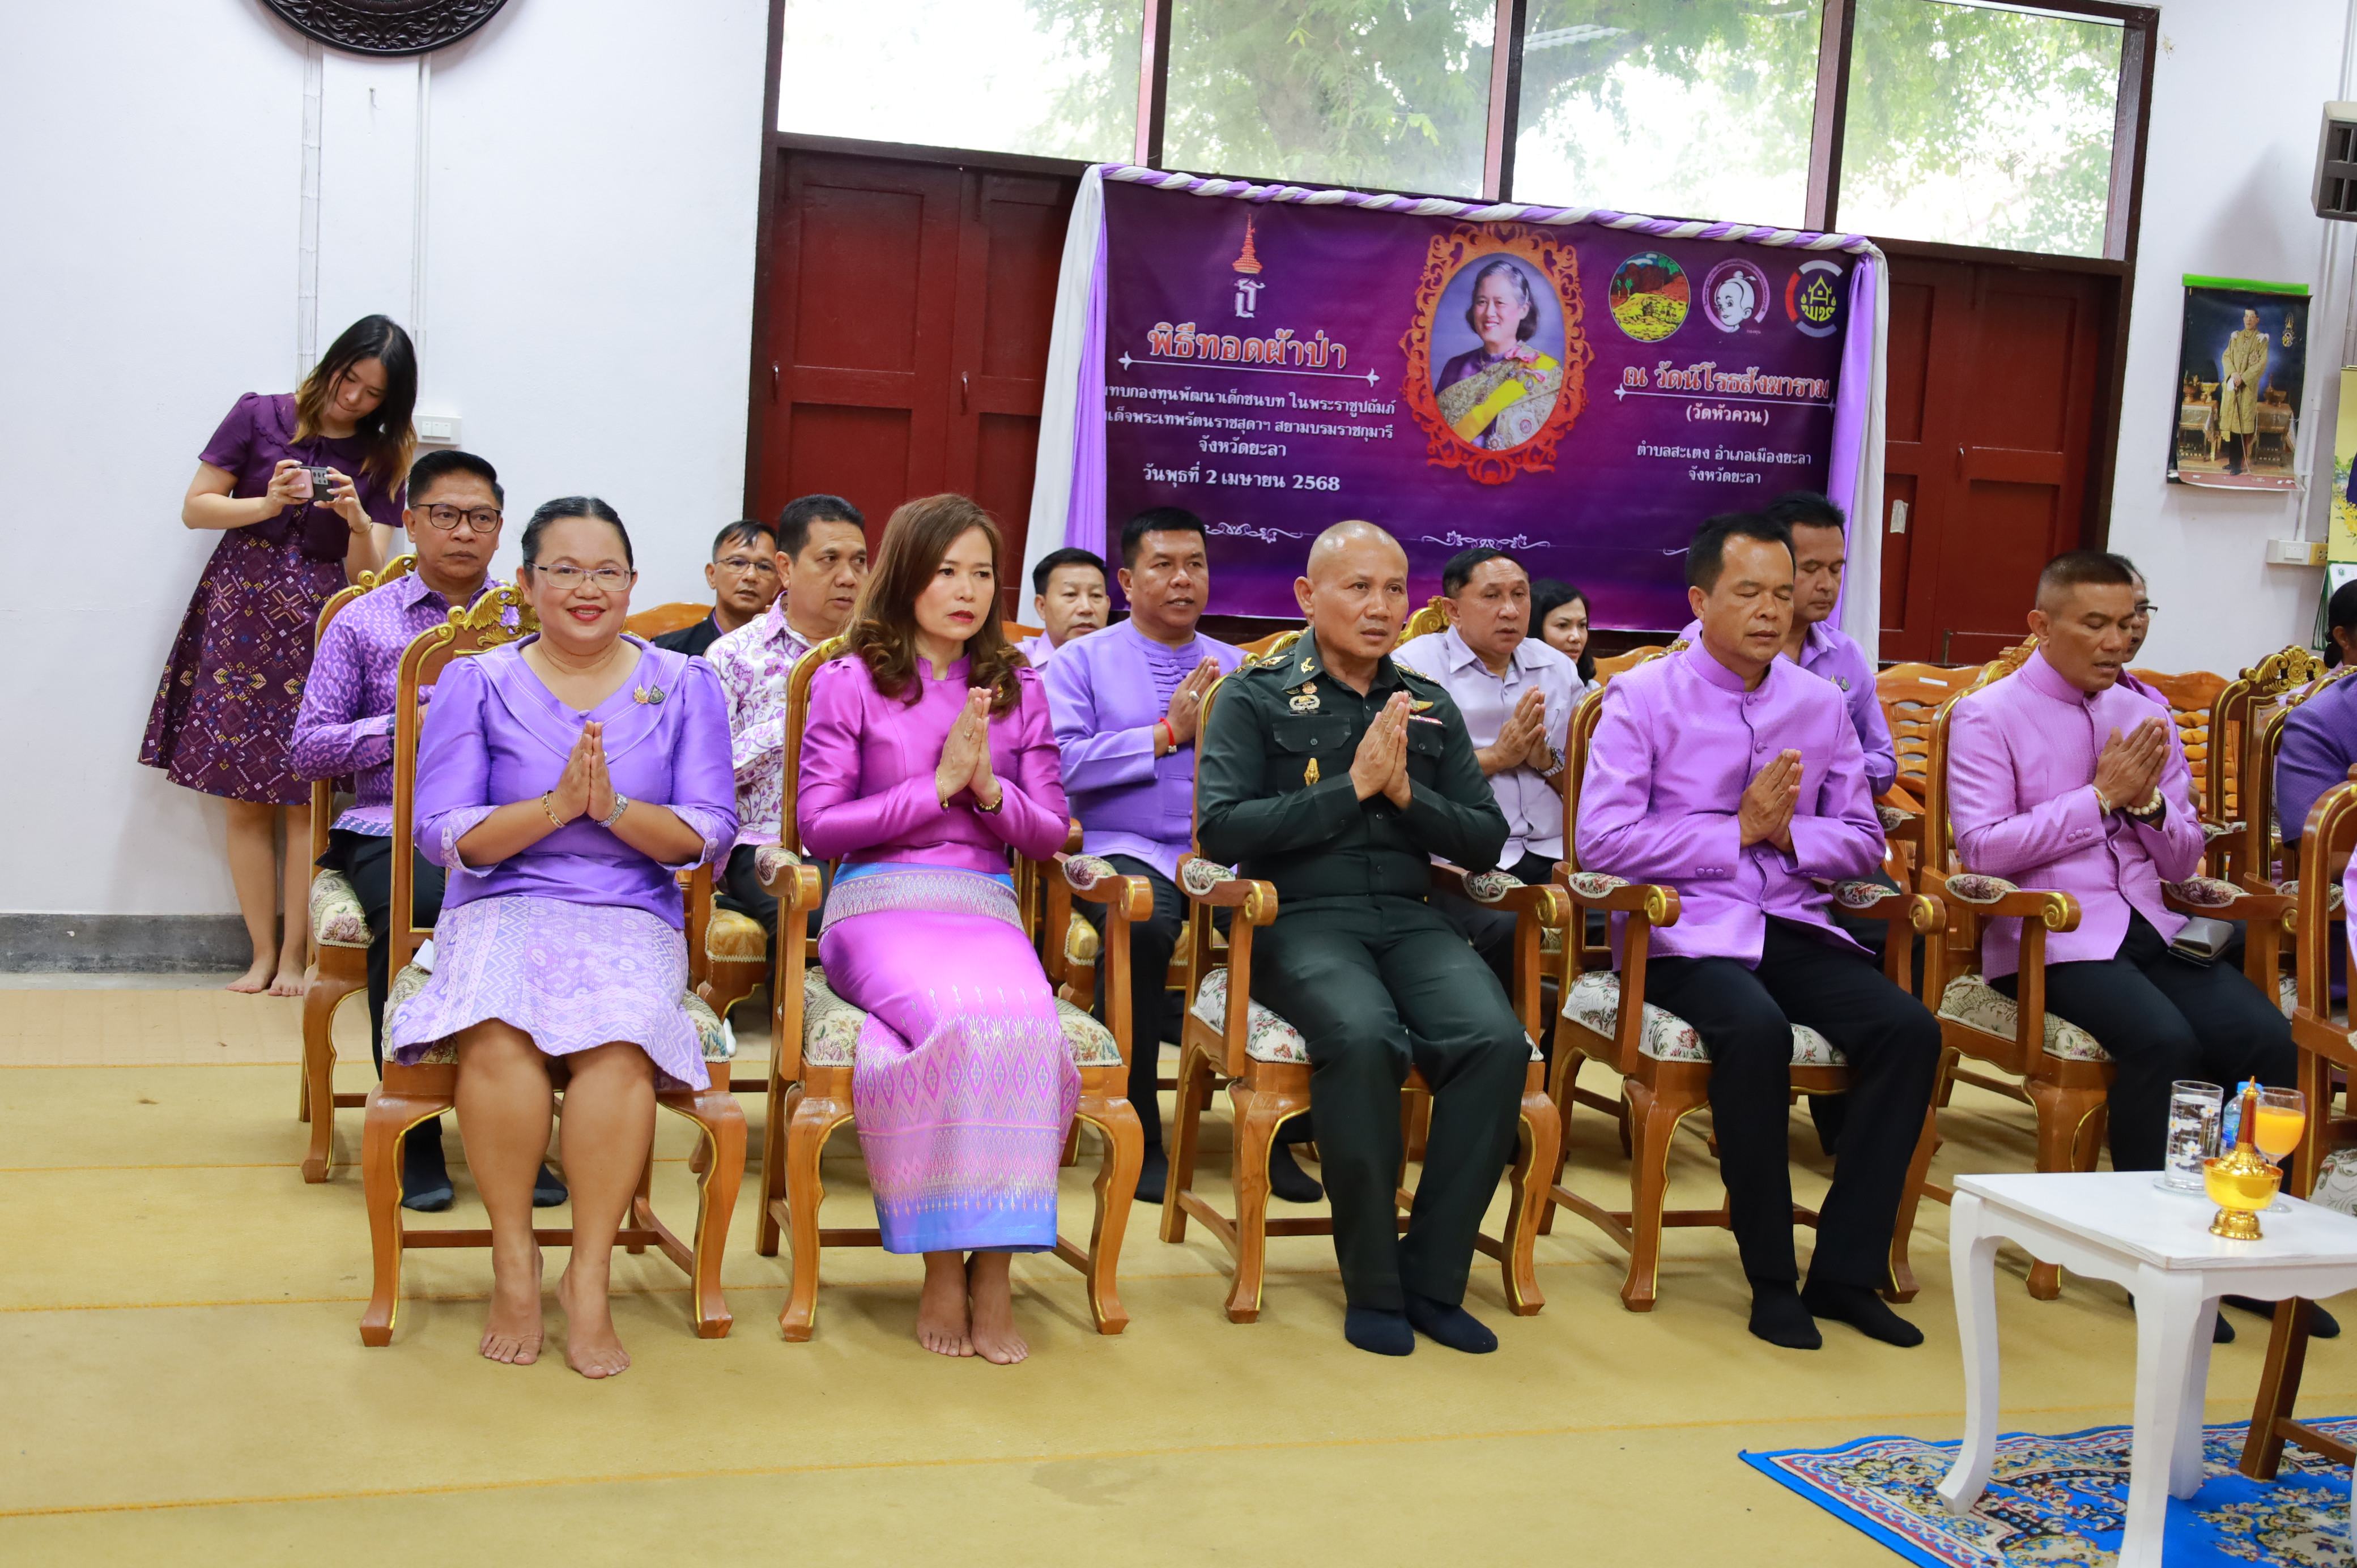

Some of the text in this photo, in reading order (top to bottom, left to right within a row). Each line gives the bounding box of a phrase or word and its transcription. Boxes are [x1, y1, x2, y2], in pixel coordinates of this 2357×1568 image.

[1147, 322, 1347, 368] พิธีทอดผ้าป่า
[1623, 361, 1830, 398] ณ วัดนิโรธสังฆาราม
[1288, 391, 1396, 418] ในพระราชูปถัมภ์
[1686, 403, 1769, 426] (วัดหัวควน)
[1105, 406, 1393, 442] เด็จพระเทพรัตนราชสุดาฯ สยามบรมราชกุมารี
[1198, 435, 1287, 457] จังหวัดยะลา
[1637, 440, 1811, 465] ตำบลสะเตง อำเภอเมืองยะลา
[1143, 461, 1341, 492] วันพุธที่ 2 เมษายน 2568
[1688, 466, 1762, 484] จังหวัดยะลา
